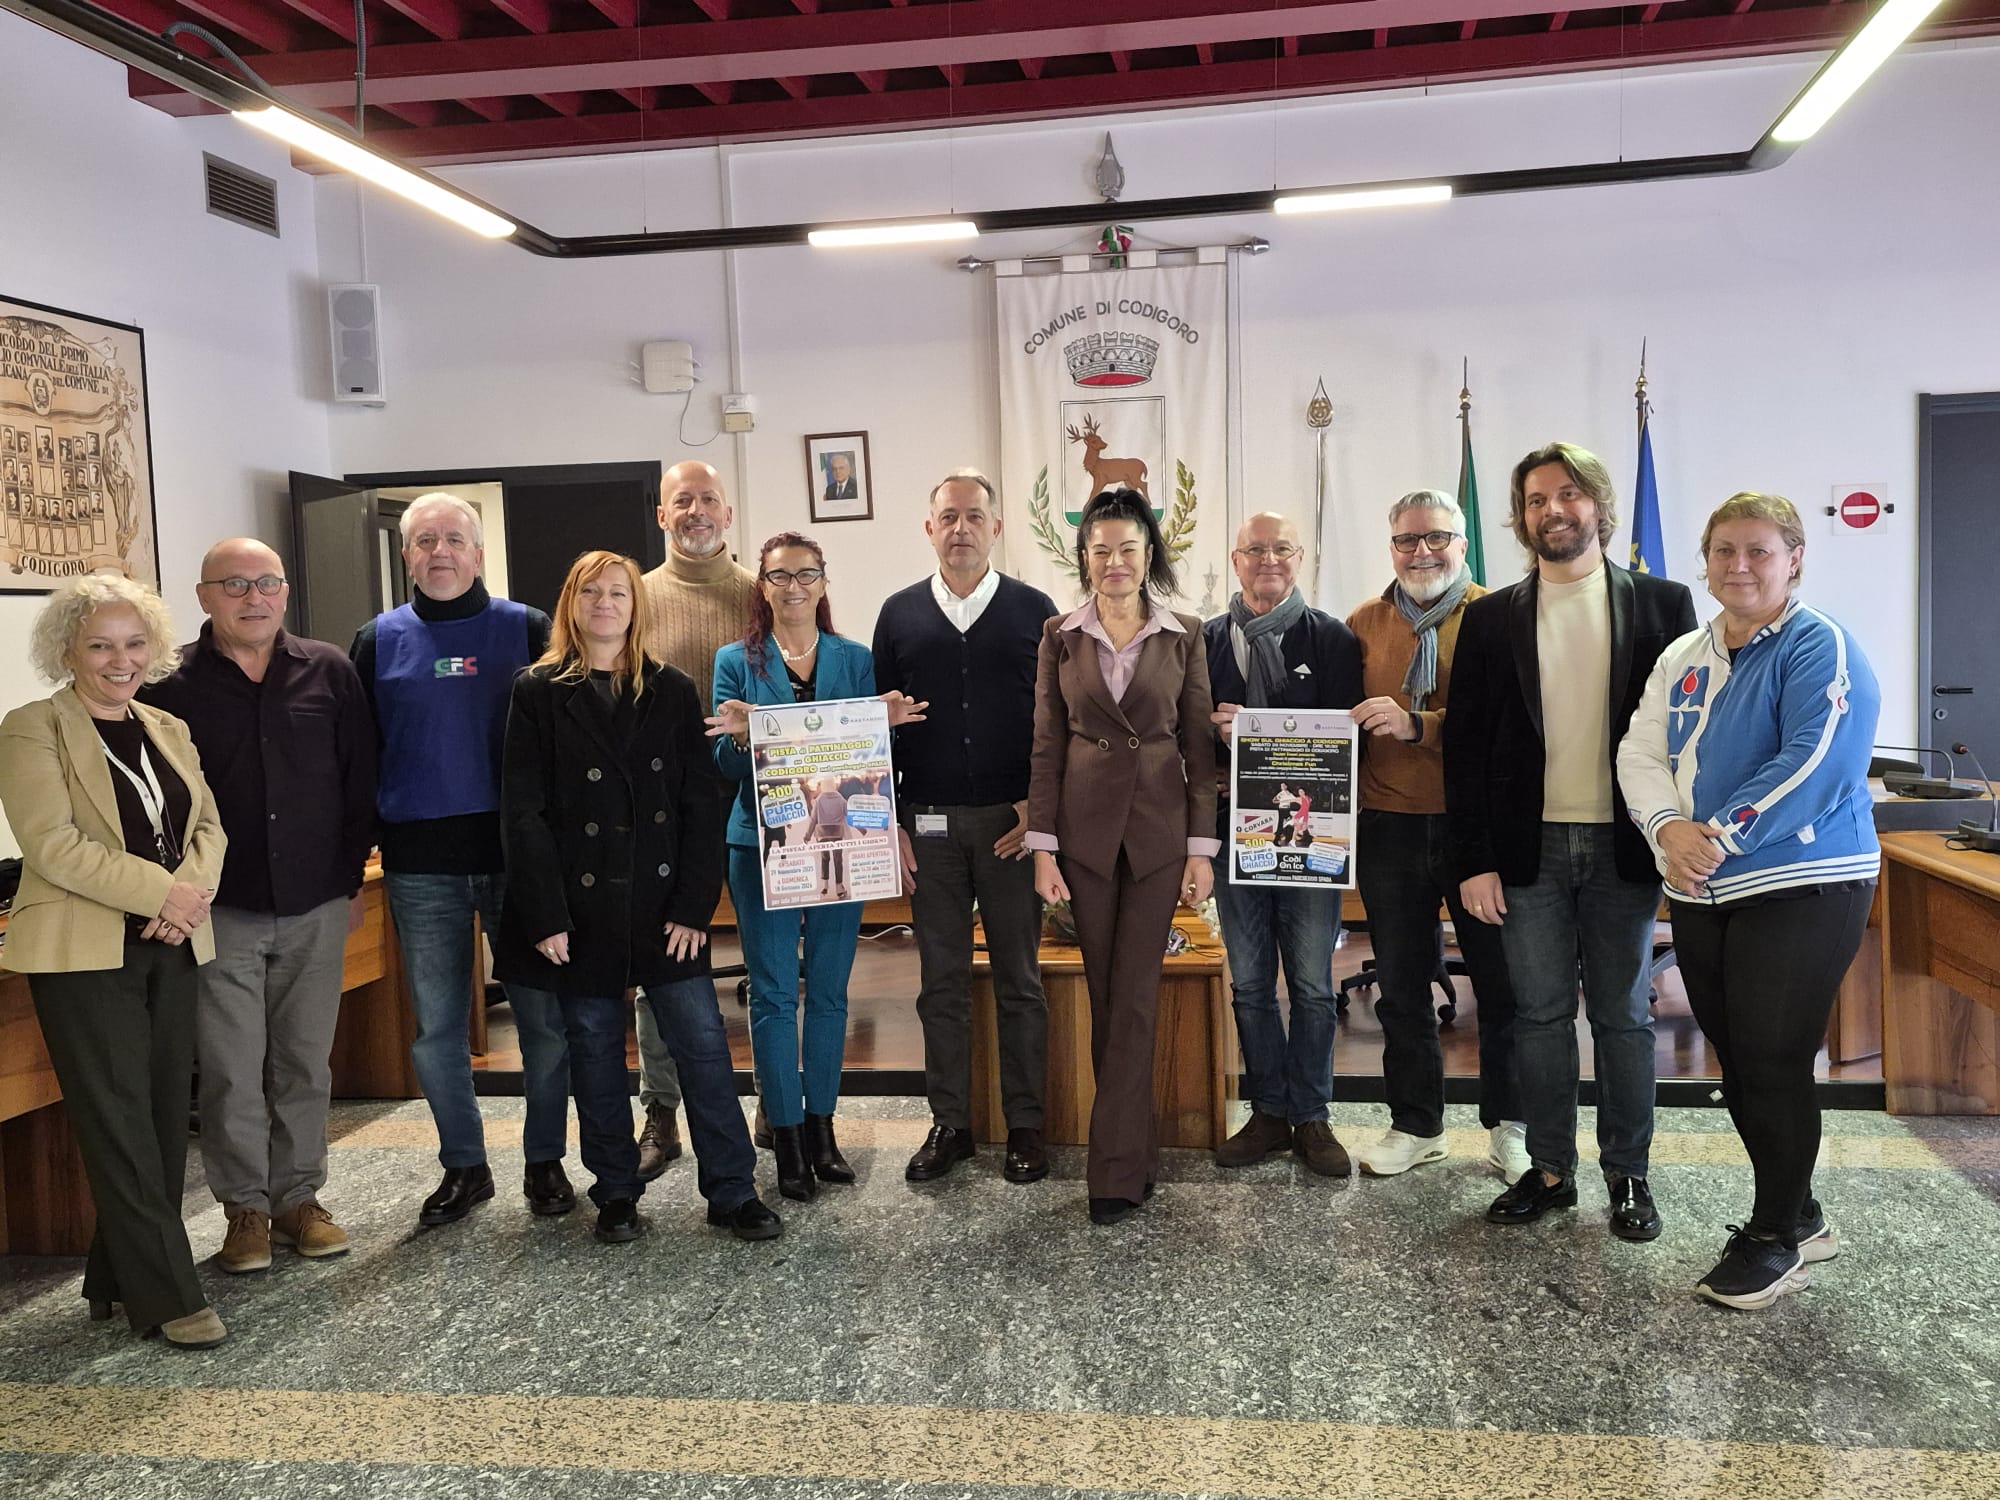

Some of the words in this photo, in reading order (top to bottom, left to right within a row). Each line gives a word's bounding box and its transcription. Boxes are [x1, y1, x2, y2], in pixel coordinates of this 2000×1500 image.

[1024, 305, 1087, 354] COMUNE
[1096, 301, 1111, 316] DI
[1118, 299, 1199, 345] CODIGORO
[39, 340, 58, 357] DEL
[60, 344, 89, 363] PRIMO
[0, 363, 30, 380] ICANA
[53, 377, 65, 387] DEL
[22, 555, 84, 577] CODIGORO
[769, 746, 797, 757] PISTA
[808, 740, 873, 754] PATTINAGGIO
[804, 752, 851, 764] GHIACCIO
[764, 765, 817, 778] CODIGORO
[768, 784, 793, 800] 500
[765, 801, 804, 817] PURO
[767, 809, 806, 825] GHIACCIO
[1244, 816, 1273, 833] CORVARA
[808, 842, 834, 851] APERTA
[837, 840, 857, 848] TUTTI
[1245, 838, 1266, 849] 500
[1241, 852, 1274, 863] PURO
[1241, 859, 1276, 870] GHIACCIO
[1293, 862, 1305, 870] Ice
